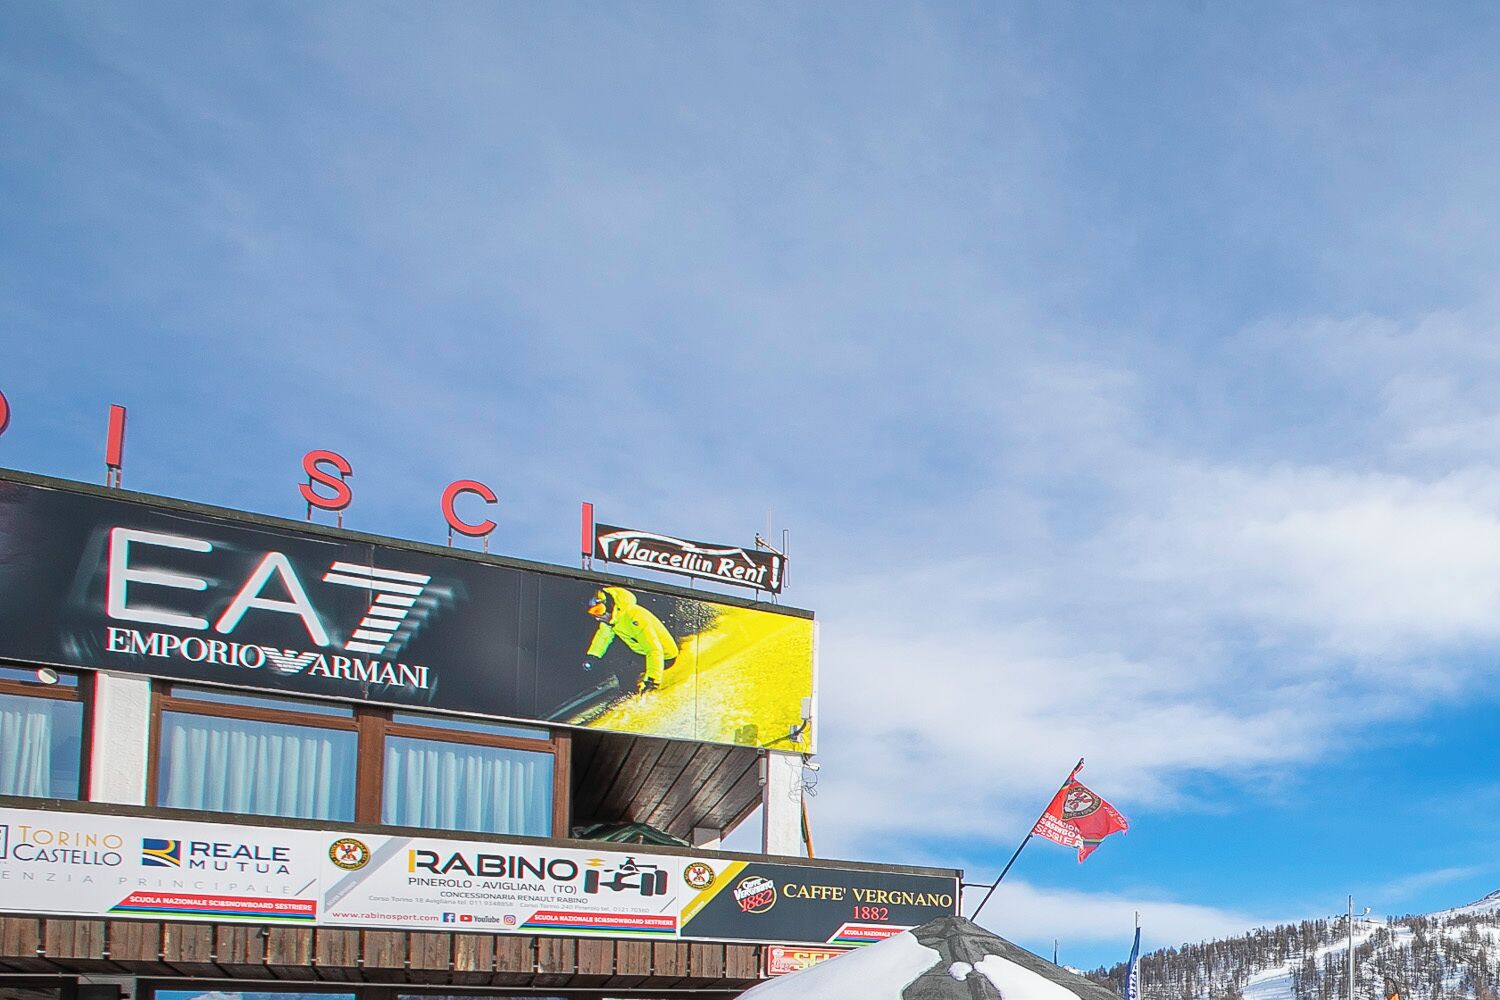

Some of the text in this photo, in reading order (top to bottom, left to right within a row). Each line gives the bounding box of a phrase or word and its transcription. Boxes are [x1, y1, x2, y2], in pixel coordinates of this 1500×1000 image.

[615, 537, 767, 584] Marcellin Rent
[107, 526, 432, 655] EA7
[106, 626, 430, 690] EMPORIO ARMANI
[18, 824, 123, 849] TORINO
[13, 843, 122, 867] CASTELLO
[190, 841, 291, 862] REALE
[189, 859, 290, 875] MUTUA
[408, 848, 580, 881] RABINO
[118, 876, 291, 894] PRINCIPALE
[408, 877, 473, 889] PINEROLO
[553, 884, 577, 895] (TO)
[129, 895, 313, 911] SCUOLA NAZIONALE SCI&SNOWBOARD SESTRIERE
[440, 891, 588, 905] CONCESSIONARIA RENAULT RABINO
[740, 889, 772, 912] 1882
[852, 887, 953, 909] VERGNANO
[332, 911, 440, 922] www.rabinosport.com
[473, 915, 500, 924] YouTube
[853, 906, 889, 921] 1882
